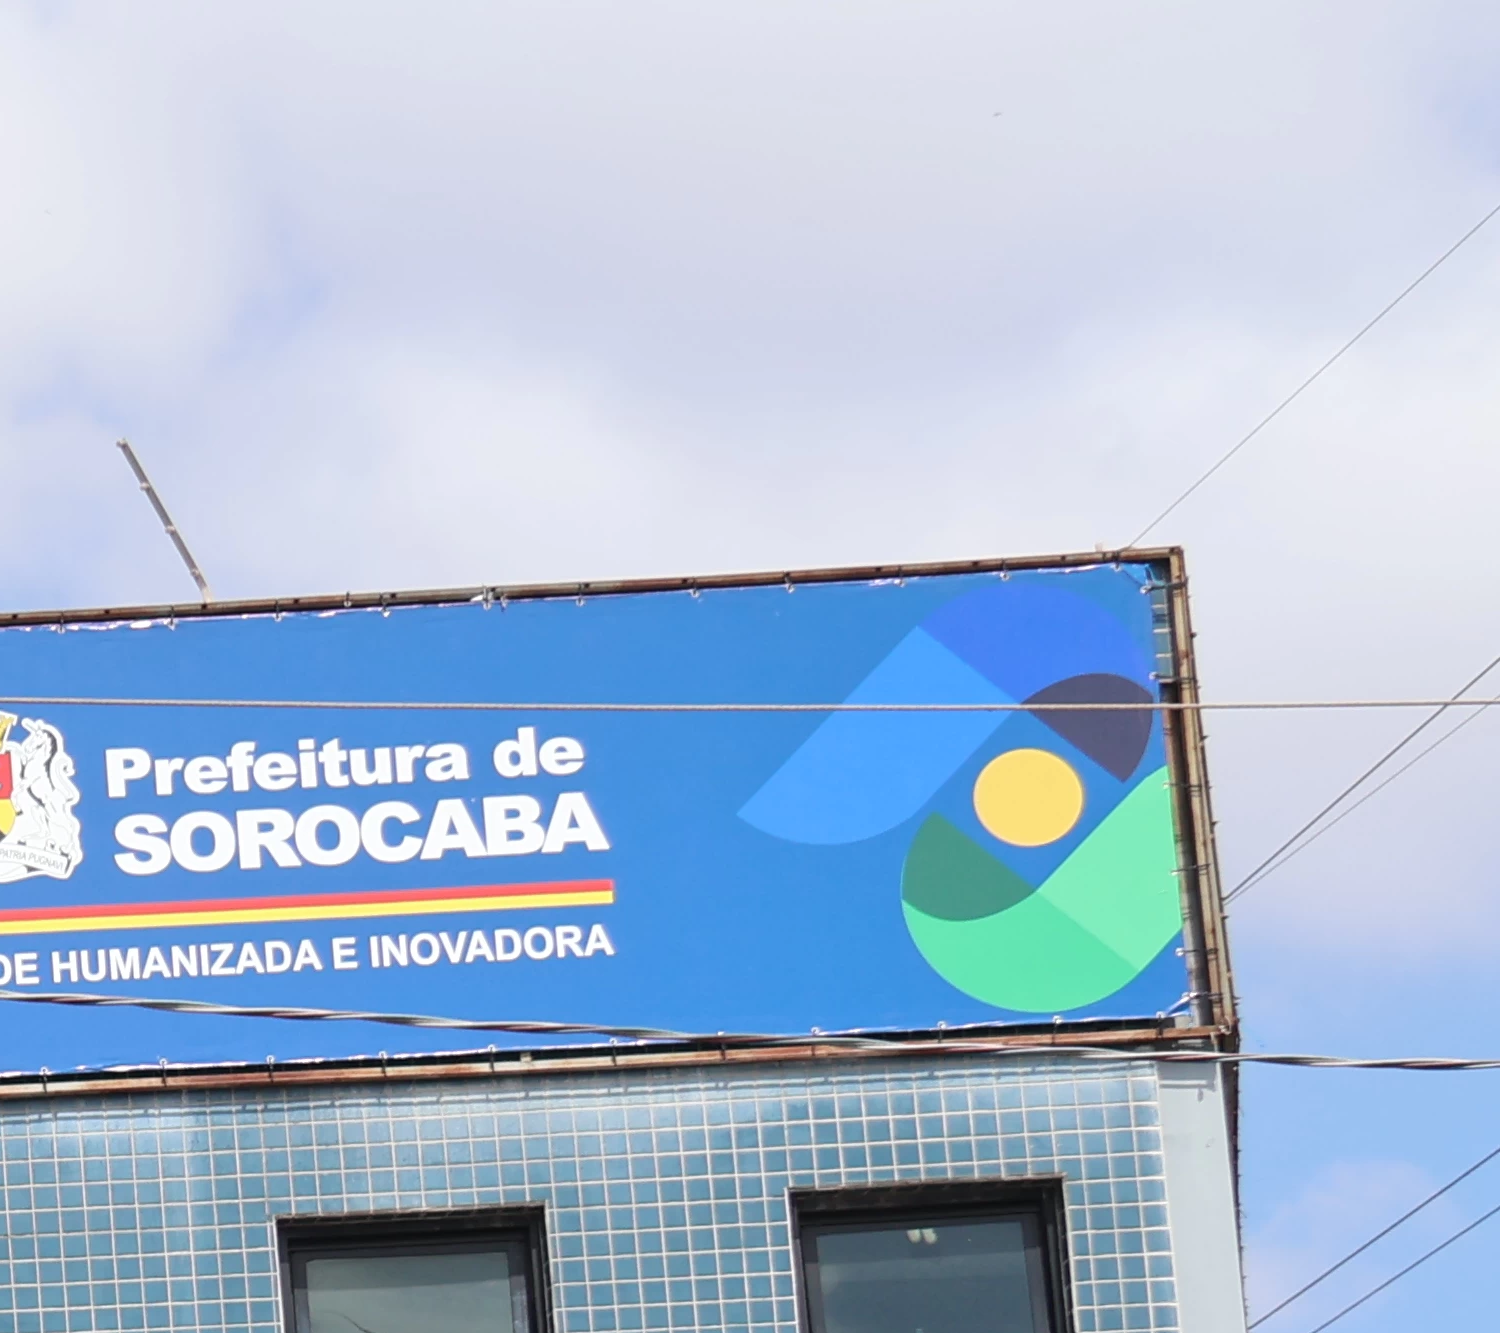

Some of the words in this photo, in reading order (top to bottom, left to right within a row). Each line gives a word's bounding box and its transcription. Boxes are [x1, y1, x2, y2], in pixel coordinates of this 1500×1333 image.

[105, 738, 470, 798] Prefeitura
[492, 726, 585, 777] de
[113, 791, 611, 877] SOROCABA
[51, 937, 323, 984] HUMANIZADA
[333, 937, 359, 969] E
[370, 924, 616, 969] INOVADORA
